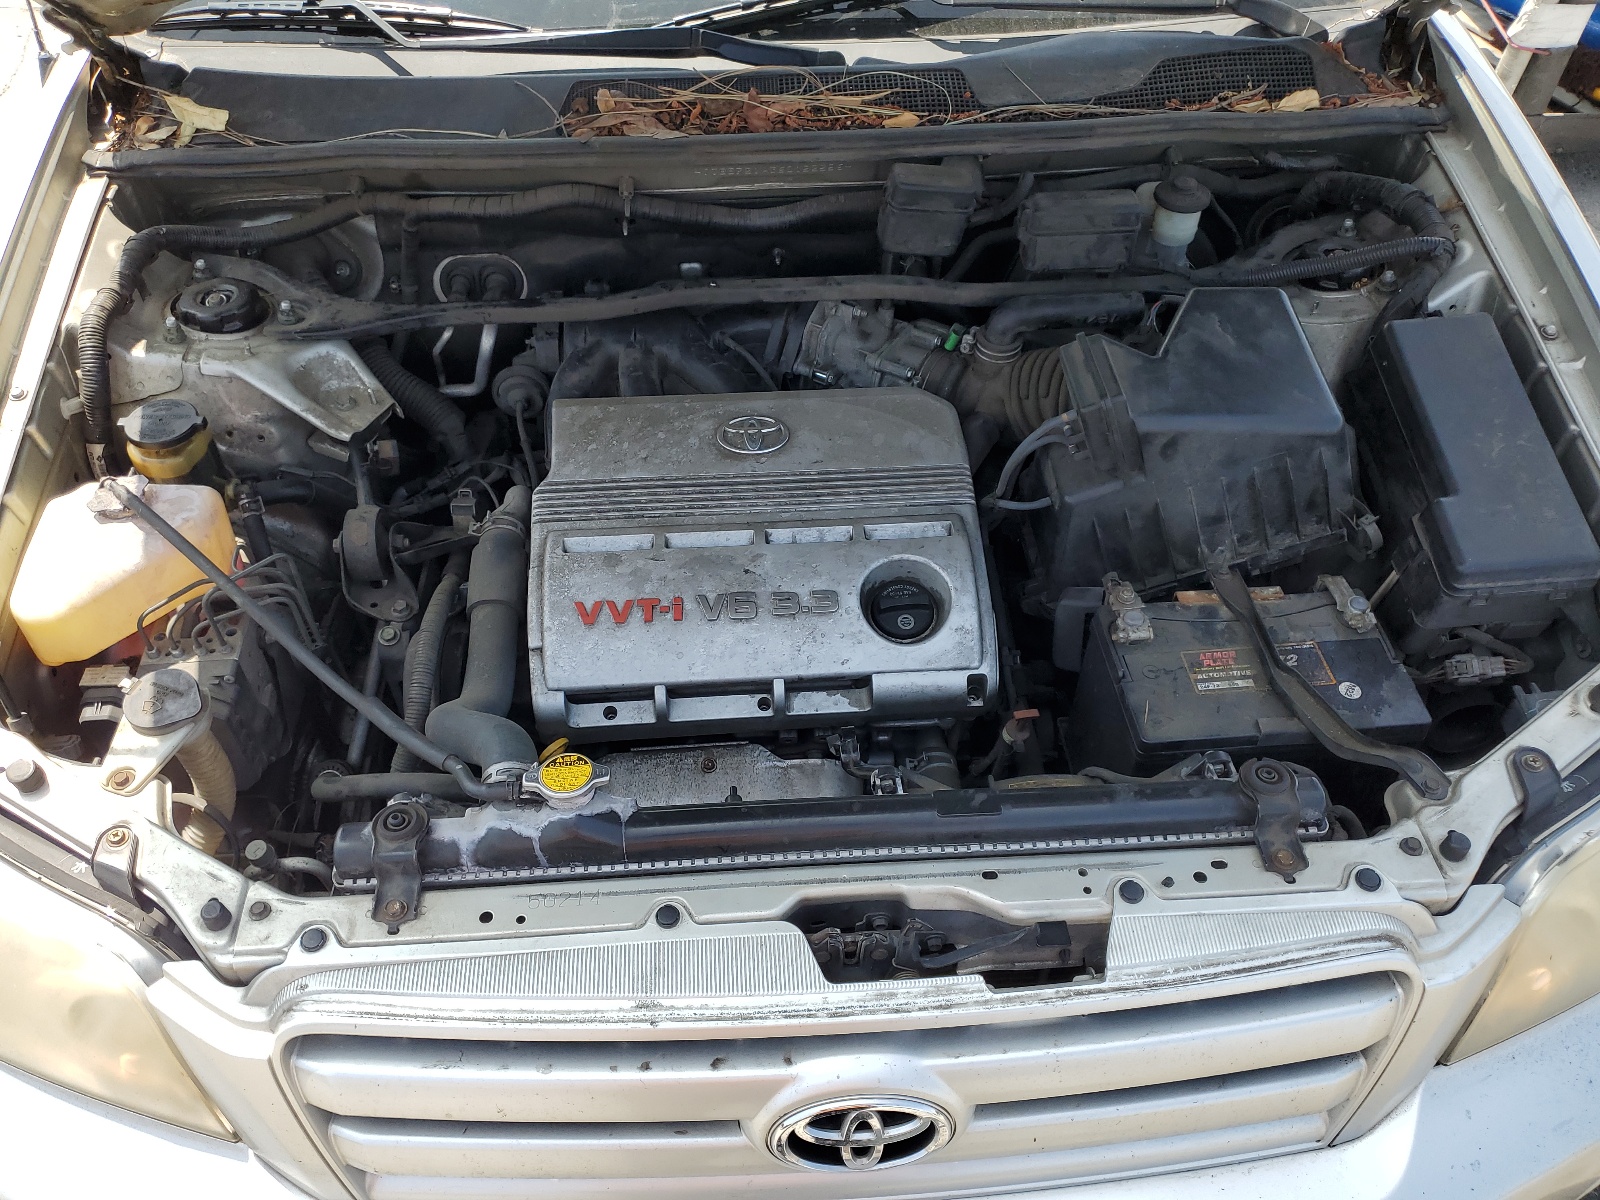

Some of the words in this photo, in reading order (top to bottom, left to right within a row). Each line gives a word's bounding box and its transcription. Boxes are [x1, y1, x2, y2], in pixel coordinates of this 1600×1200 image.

[574, 596, 684, 625] VVT-i
[695, 591, 758, 621] V6
[770, 590, 840, 617] 3.3
[1200, 651, 1236, 660] ARMOR
[1203, 658, 1235, 667] PLATE
[1198, 670, 1252, 679] AUTOMOTIVE
[549, 760, 585, 768] CAUTION
[528, 889, 600, 910] 50214
